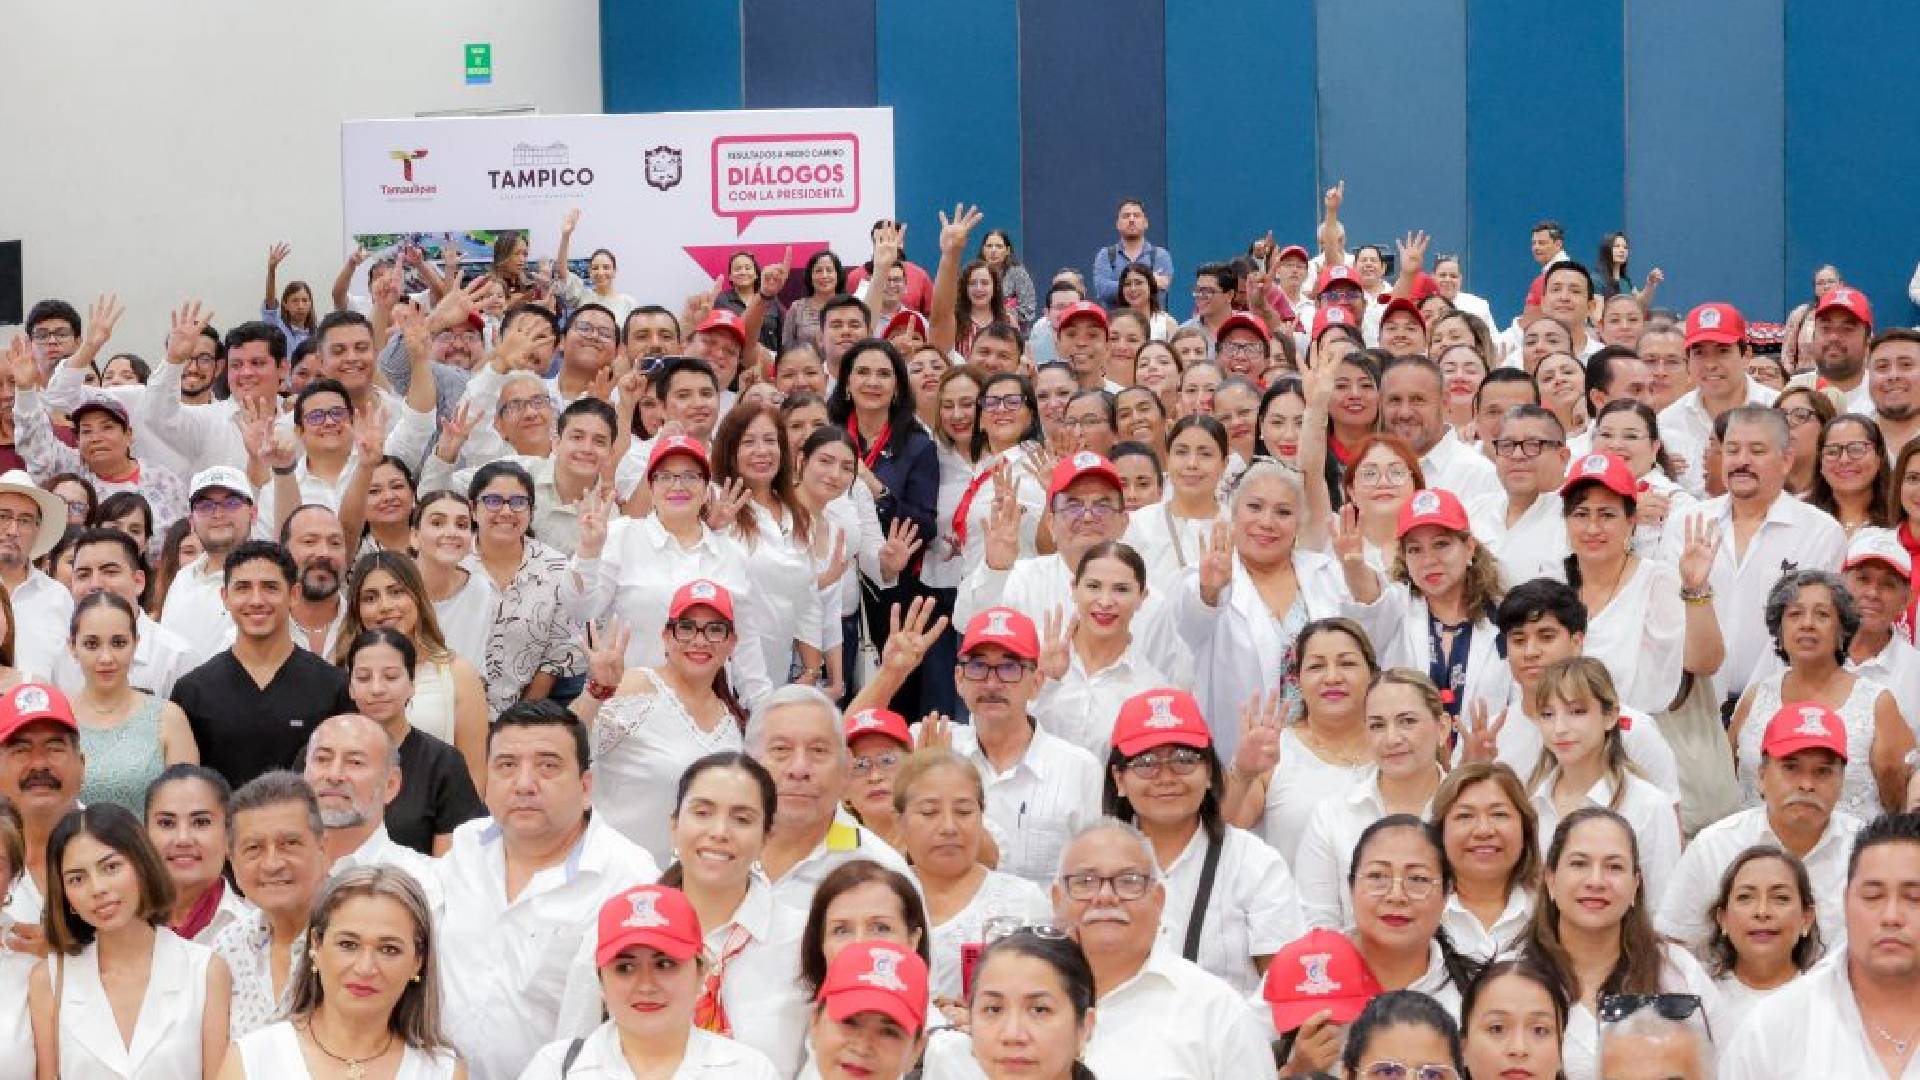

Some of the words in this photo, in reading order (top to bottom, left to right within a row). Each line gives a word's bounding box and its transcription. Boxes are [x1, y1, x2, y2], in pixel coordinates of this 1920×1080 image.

[488, 167, 594, 190] TAMPICO
[728, 163, 844, 186] DIÁLOGOS
[379, 184, 438, 196] Tamaulipas
[728, 190, 757, 201] CON
[760, 190, 773, 200] LA
[777, 187, 845, 199] PRESIDENTA
